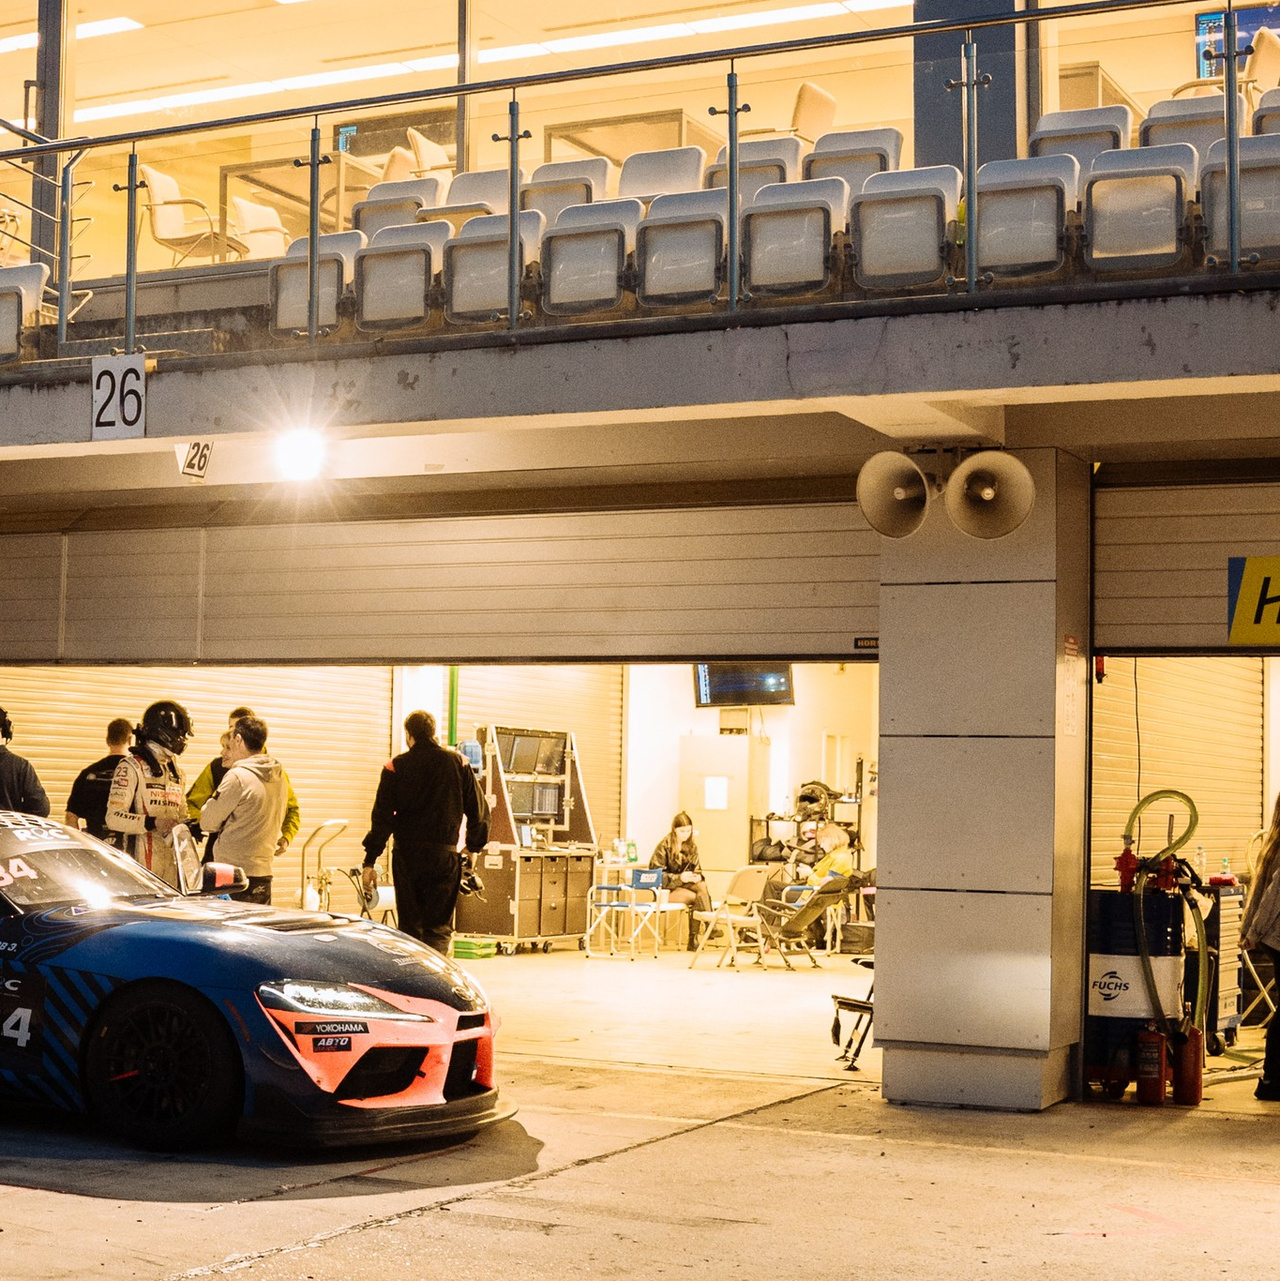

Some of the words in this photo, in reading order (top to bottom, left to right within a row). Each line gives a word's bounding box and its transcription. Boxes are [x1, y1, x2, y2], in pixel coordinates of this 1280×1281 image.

[95, 367, 142, 427] 26
[186, 442, 210, 471] 26
[116, 766, 128, 777] 23
[1092, 981, 1130, 991] FUCHS
[315, 1023, 364, 1033] YOKOHAMA
